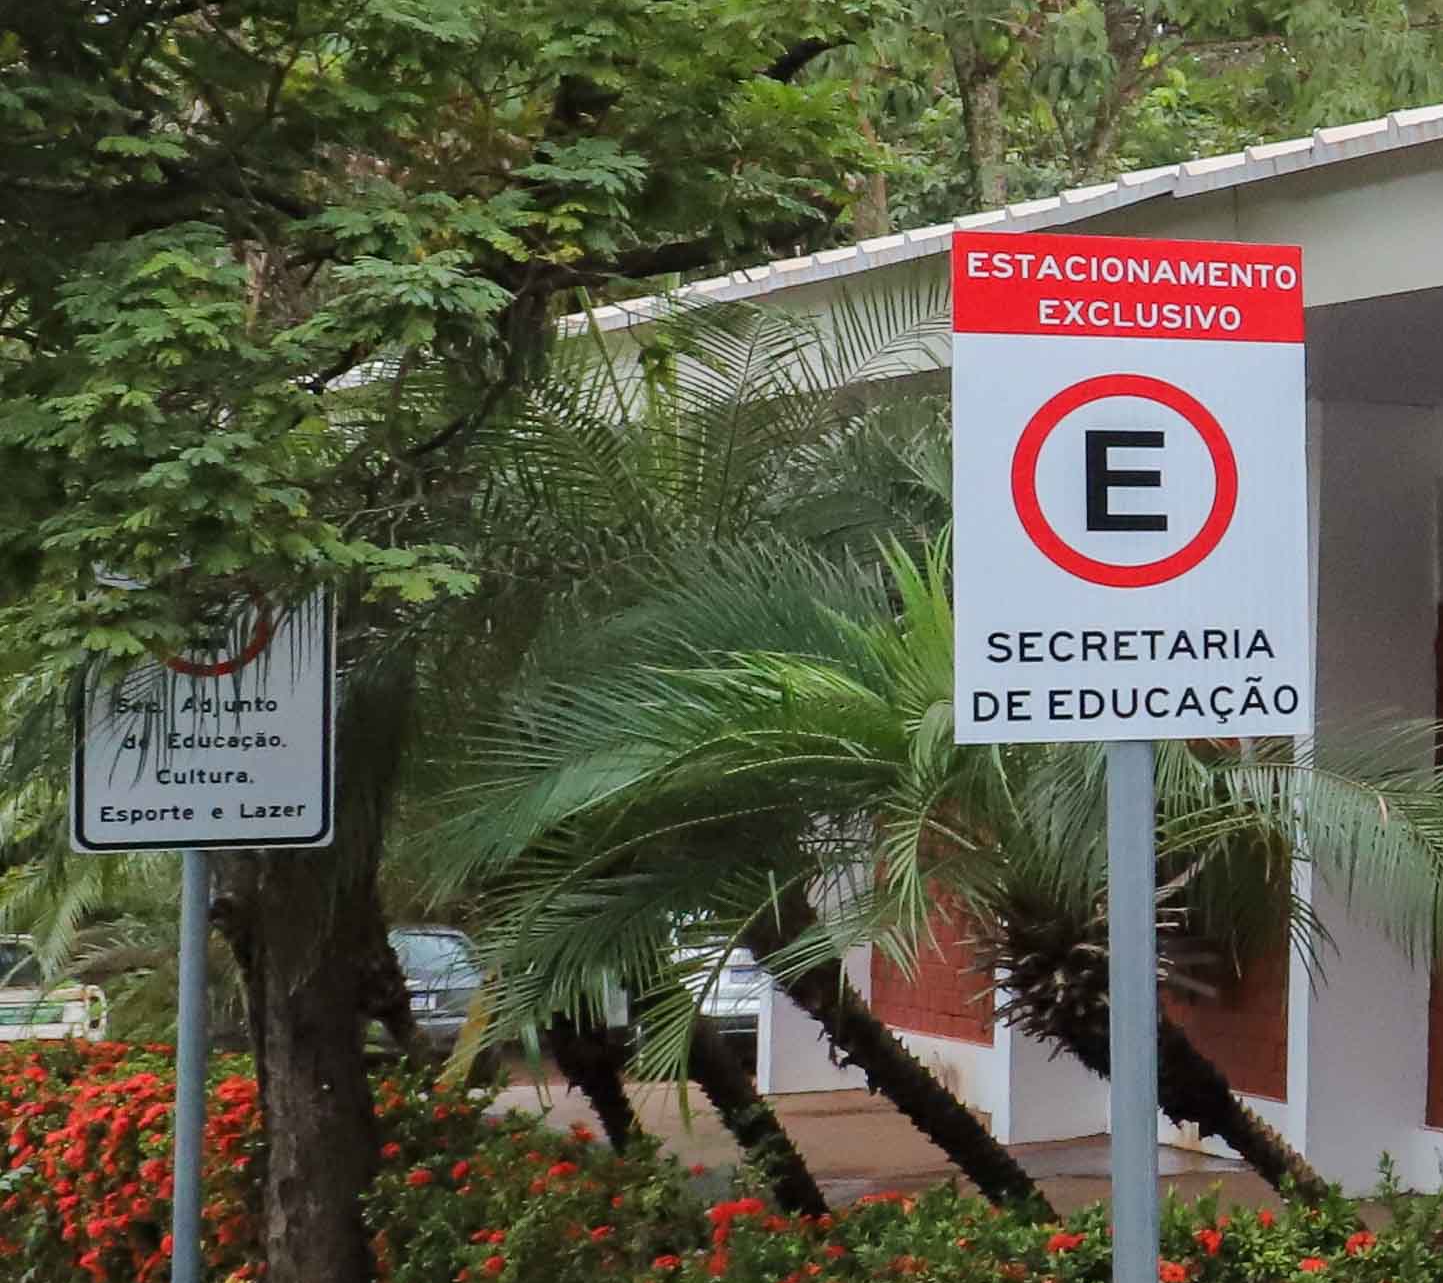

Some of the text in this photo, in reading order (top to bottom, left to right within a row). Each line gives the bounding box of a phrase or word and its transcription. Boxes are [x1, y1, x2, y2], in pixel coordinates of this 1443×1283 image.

[966, 251, 1296, 290] ESTACIONAMENTO
[1038, 299, 1241, 331] EXCLUSIVO
[1085, 430, 1168, 532] E
[987, 629, 1275, 664] SECRETARIA
[180, 697, 278, 718] Adjunto
[973, 676, 1299, 724] DE EDUCAÇÃO
[100, 803, 306, 824] Esporte e Lazer
